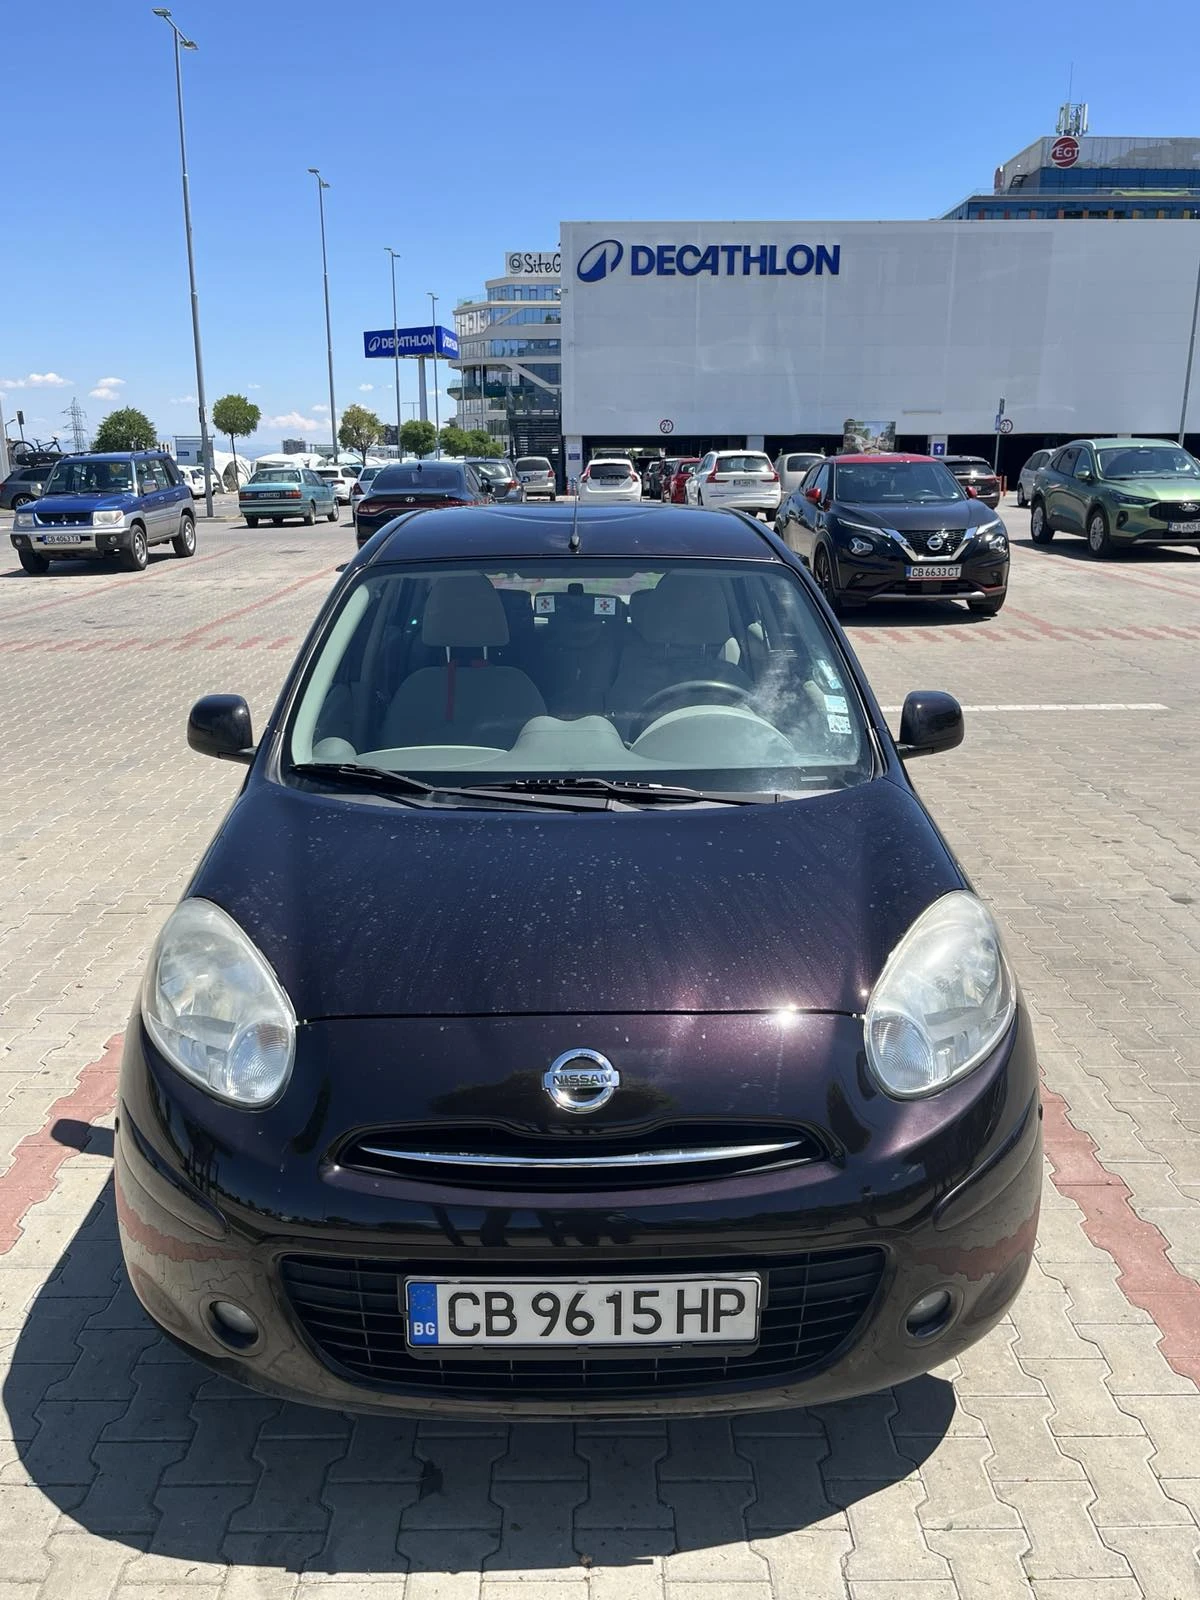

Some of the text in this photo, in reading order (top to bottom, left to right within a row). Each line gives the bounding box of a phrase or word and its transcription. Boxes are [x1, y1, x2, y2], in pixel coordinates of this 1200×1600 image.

[1056, 147, 1080, 157] EGT
[631, 244, 841, 276] DECATHLON
[912, 567, 960, 577] CB 6633 CT
[552, 1074, 612, 1085] NISSAN
[447, 1288, 746, 1338] CB 9615 HP
[413, 1321, 436, 1336] BG
